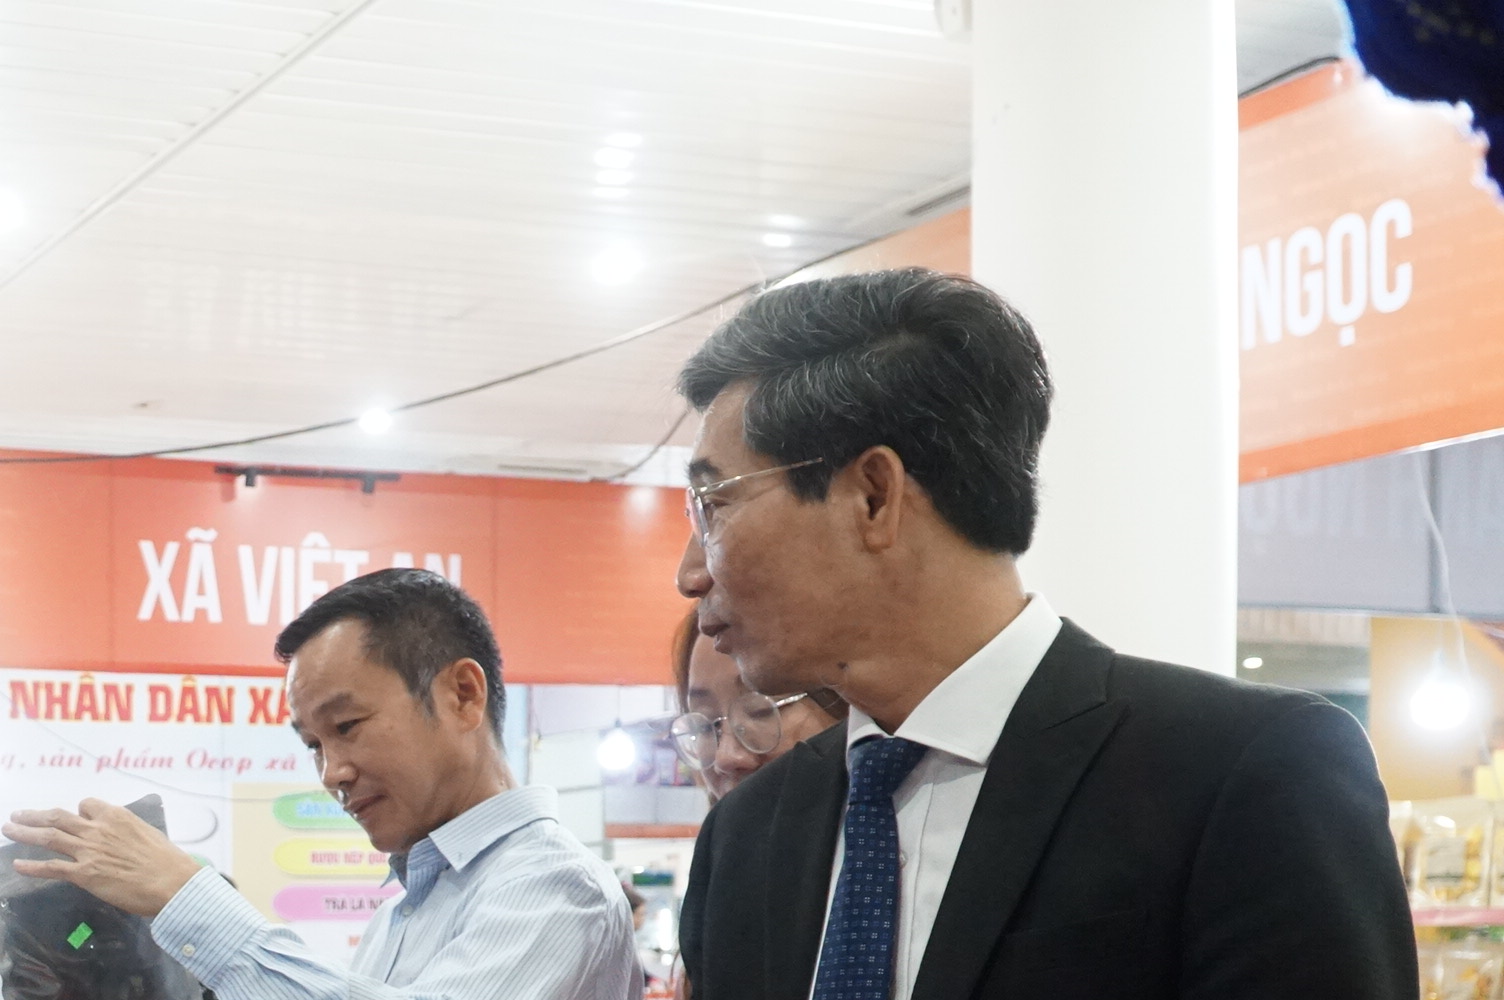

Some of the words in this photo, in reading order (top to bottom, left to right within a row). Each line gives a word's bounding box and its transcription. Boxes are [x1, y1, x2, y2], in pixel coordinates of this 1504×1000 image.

[1240, 198, 1413, 351] NGỌC
[137, 526, 223, 623] XÃ
[9, 671, 134, 722] NHÂN
[148, 673, 235, 724] DÂN
